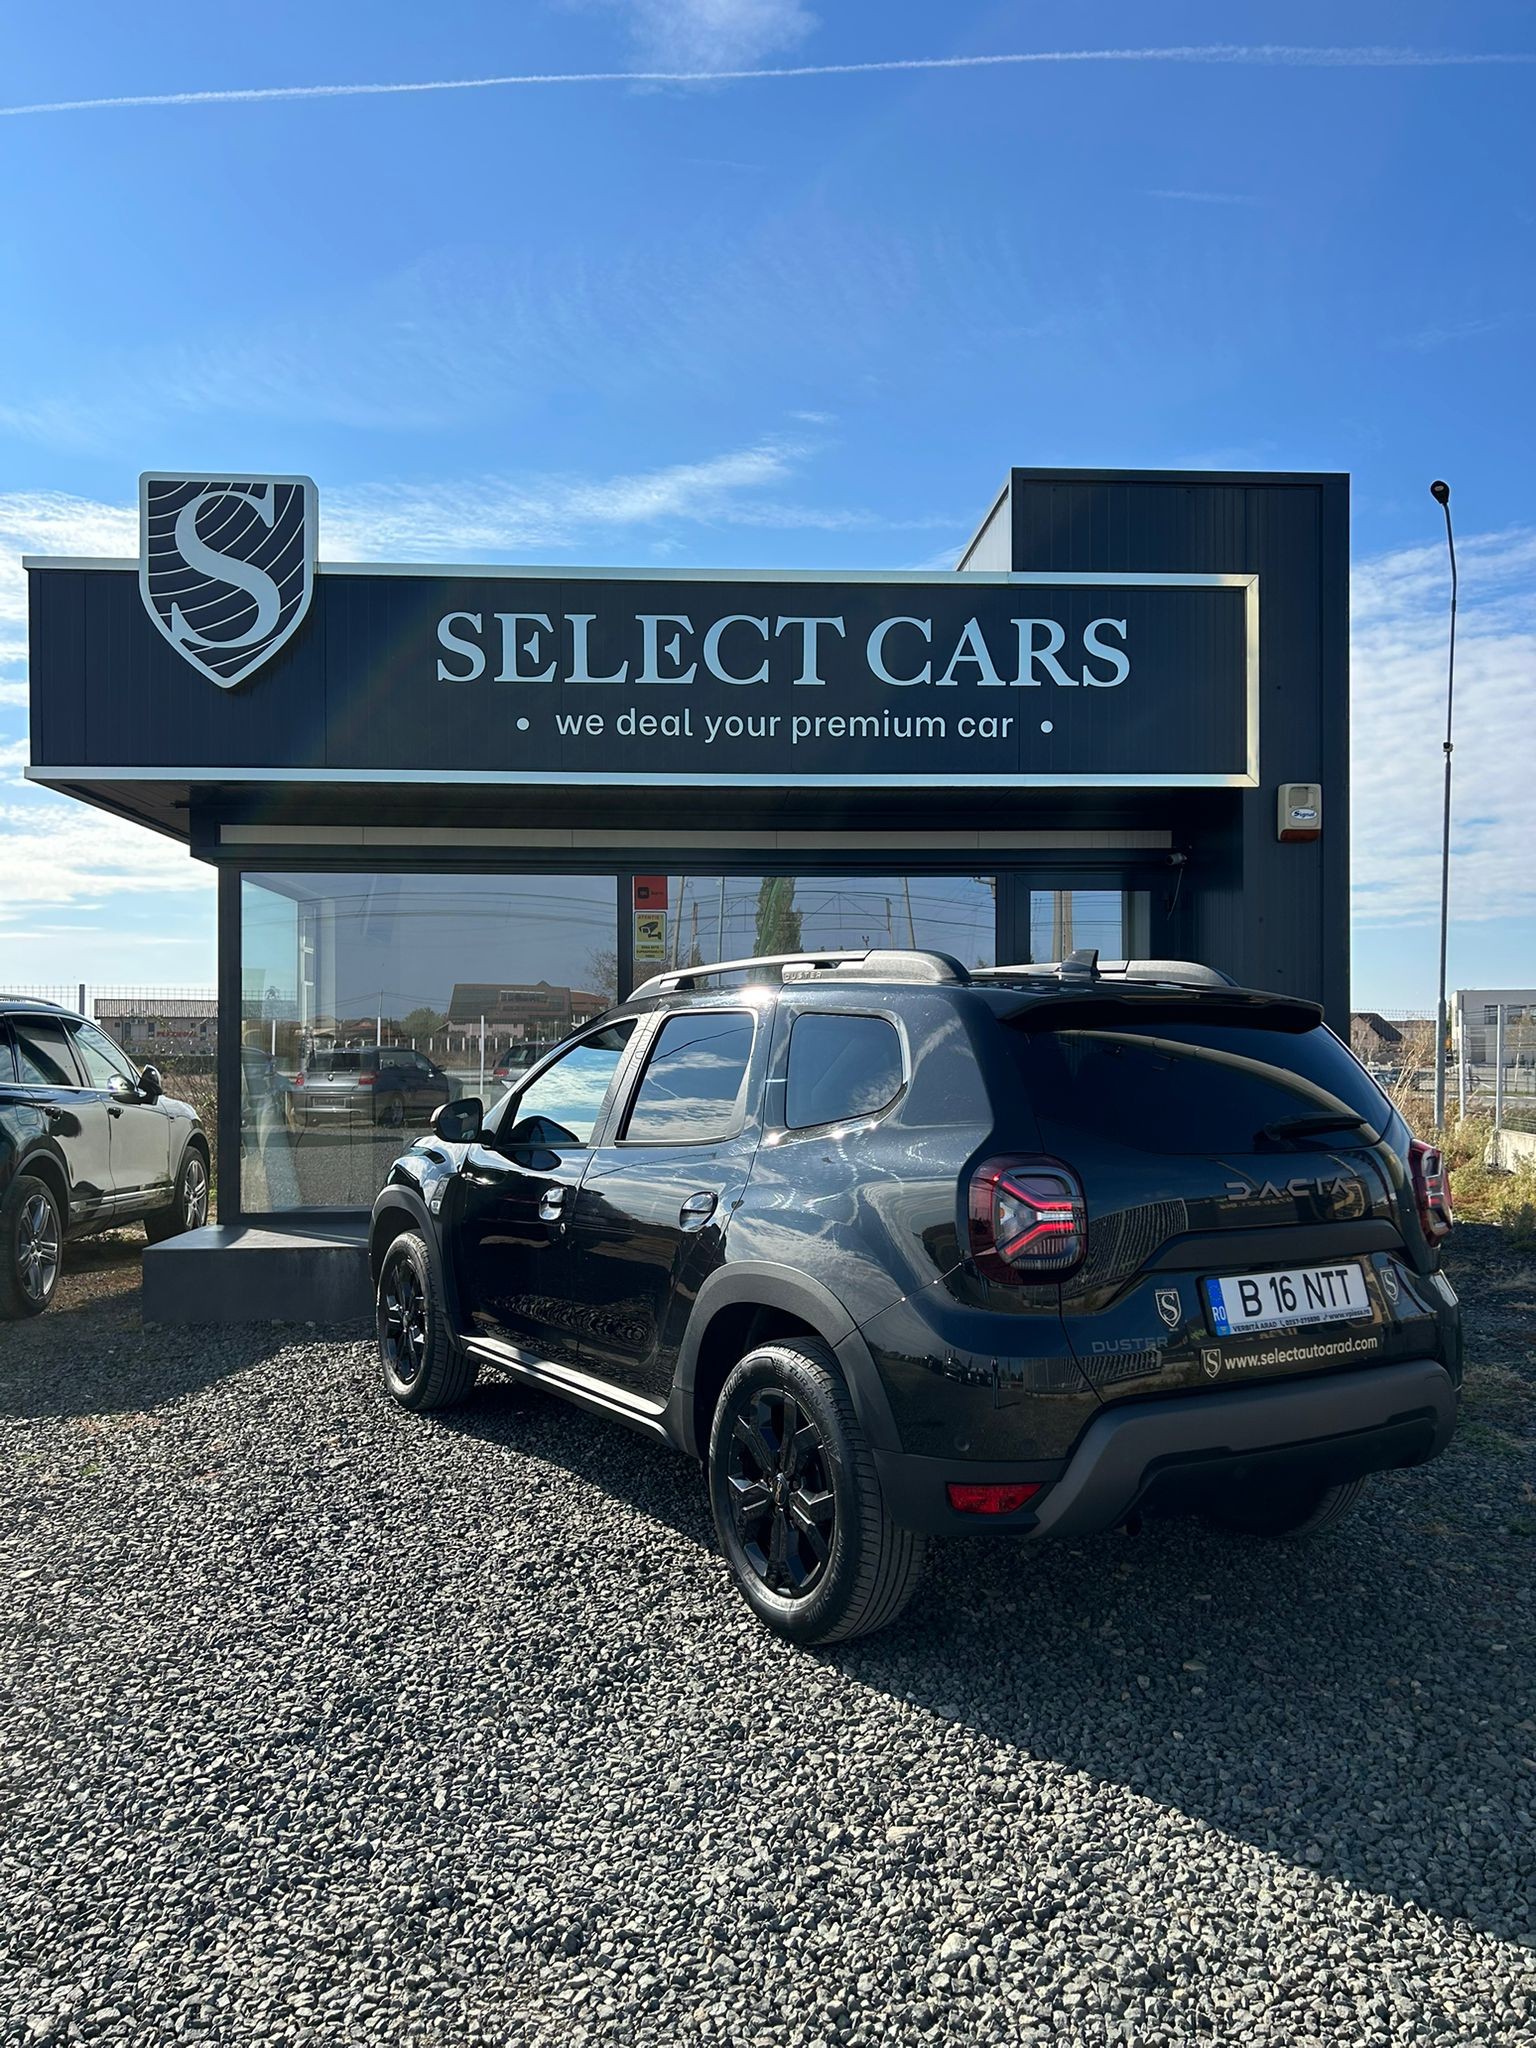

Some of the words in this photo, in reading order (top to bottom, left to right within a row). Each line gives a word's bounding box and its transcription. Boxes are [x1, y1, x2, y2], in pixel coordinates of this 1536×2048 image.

[436, 611, 846, 685] SELECT
[866, 615, 1131, 688] CARS
[555, 713, 604, 735] we
[616, 708, 693, 737] deal
[704, 713, 781, 744] your
[791, 708, 946, 744] premium
[957, 713, 1013, 738] car
[783, 971, 822, 980] DUSTER
[1225, 1177, 1350, 1200] DACIA
[1238, 1280, 1263, 1317] B
[1269, 1275, 1298, 1313] 16
[1303, 1269, 1350, 1310] NTT
[1212, 1306, 1226, 1321] RO
[1260, 1321, 1278, 1329] ARAD
[1091, 1336, 1169, 1353] DUSTER
[1225, 1337, 1378, 1370] www.selectautoarad.com
